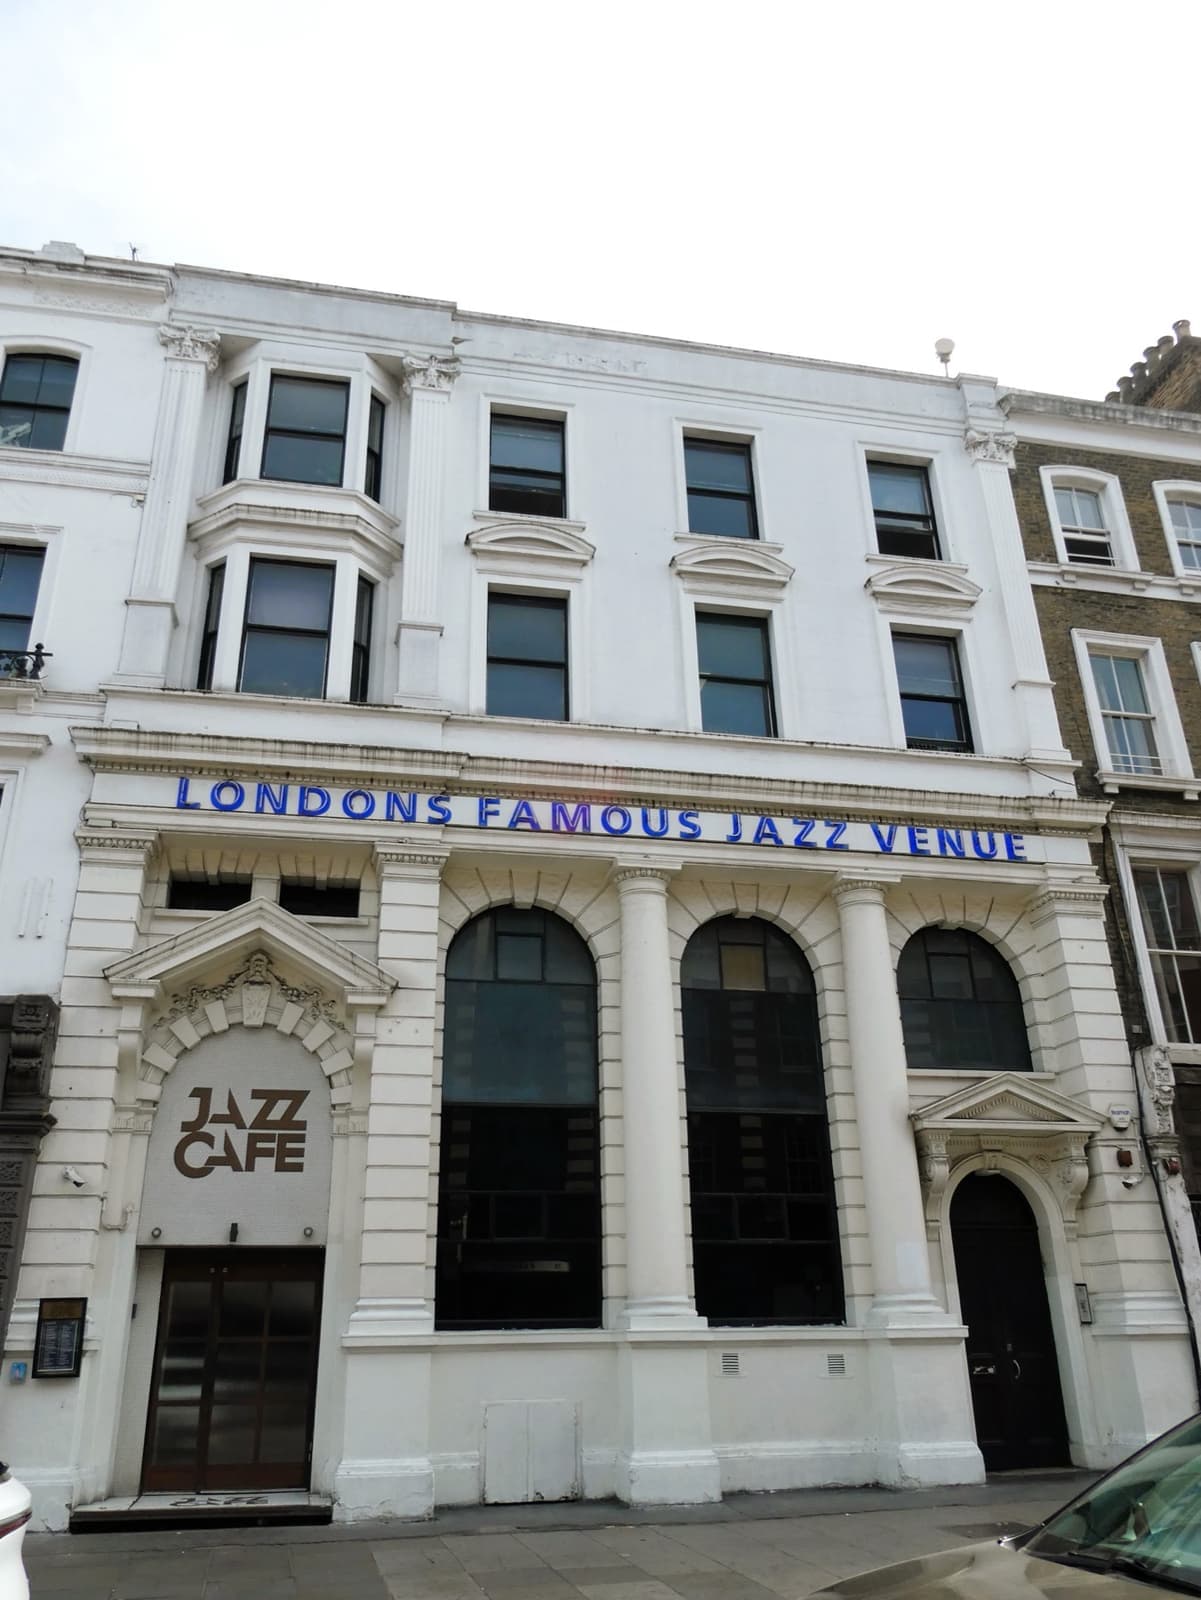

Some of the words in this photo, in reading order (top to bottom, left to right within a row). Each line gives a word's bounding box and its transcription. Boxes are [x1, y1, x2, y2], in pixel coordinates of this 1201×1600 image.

[177, 777, 453, 825] LONDONS
[478, 796, 703, 841] FAMOUS
[726, 812, 849, 850] JAZZ
[871, 822, 1027, 862] VENUE
[180, 1086, 311, 1132] JAZZ
[174, 1129, 306, 1179] CAFE
